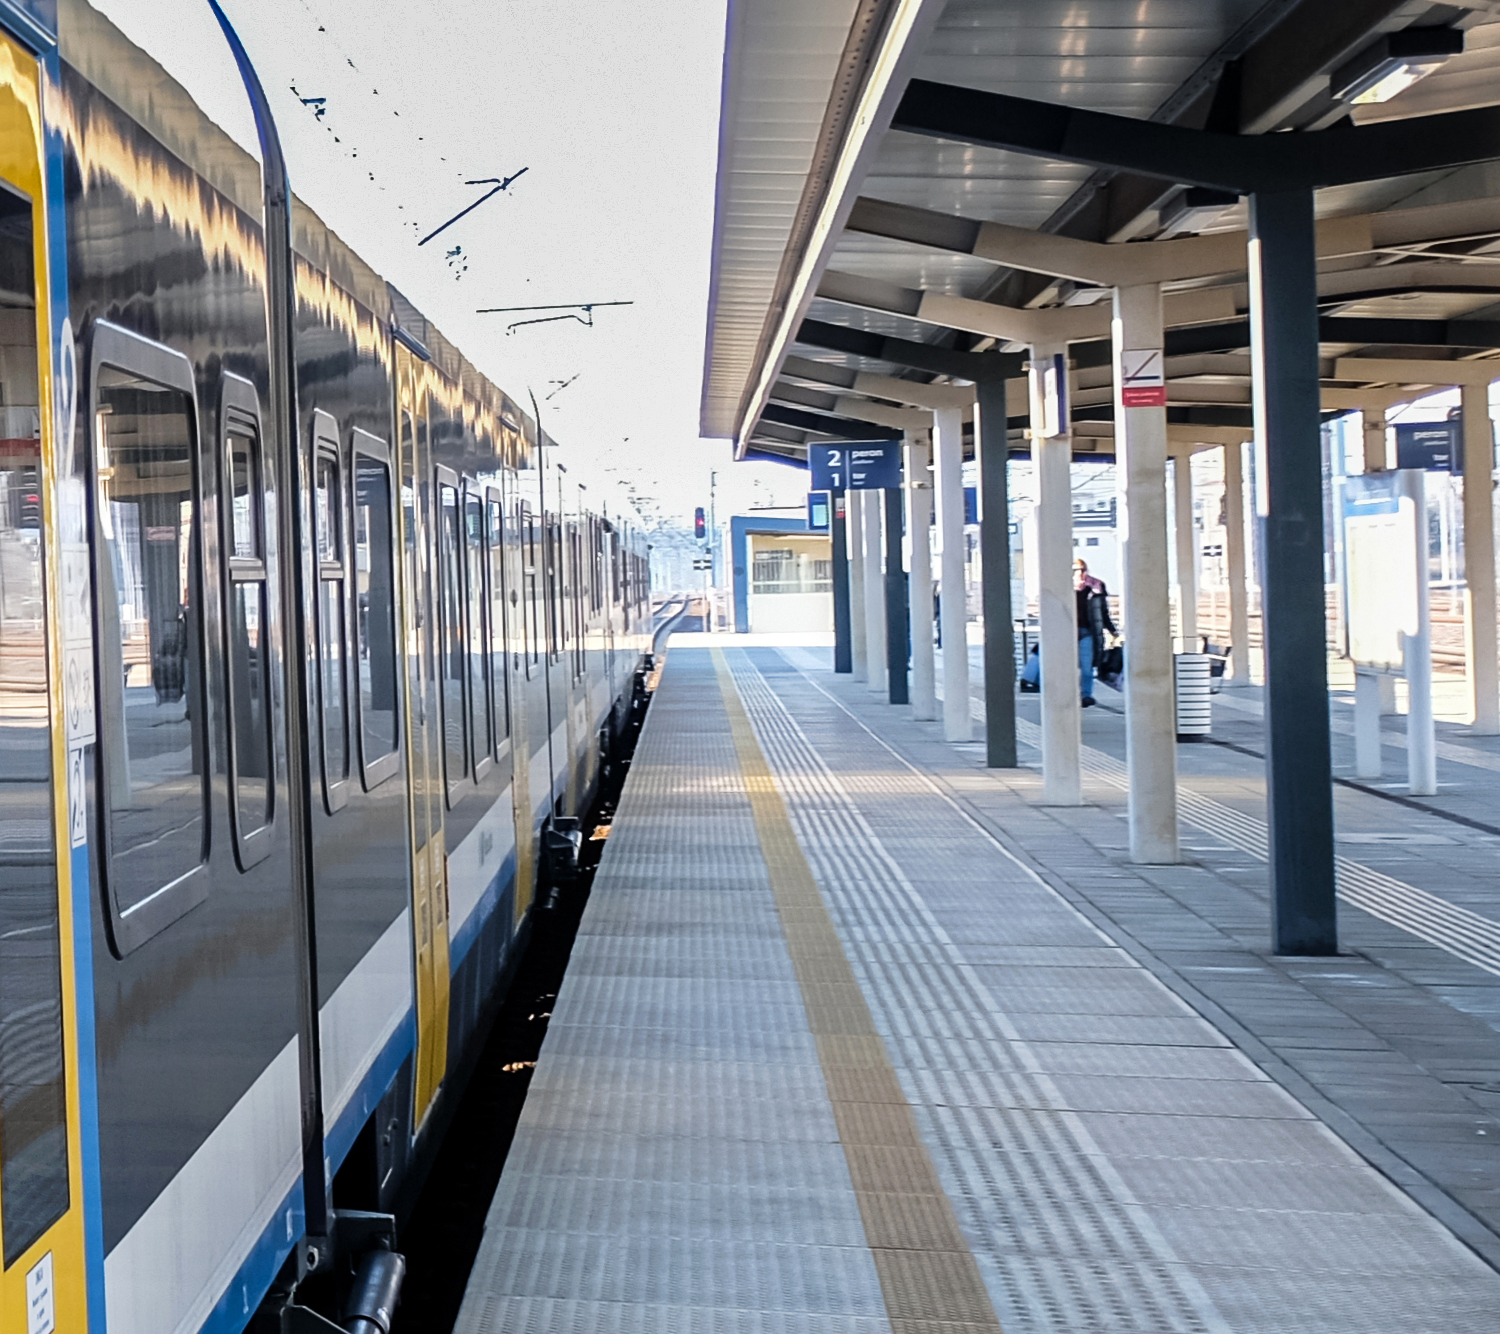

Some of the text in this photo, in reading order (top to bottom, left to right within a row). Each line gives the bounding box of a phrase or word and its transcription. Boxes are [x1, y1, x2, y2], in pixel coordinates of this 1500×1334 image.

[828, 450, 884, 466] 2 peron
[831, 473, 840, 486] 1
